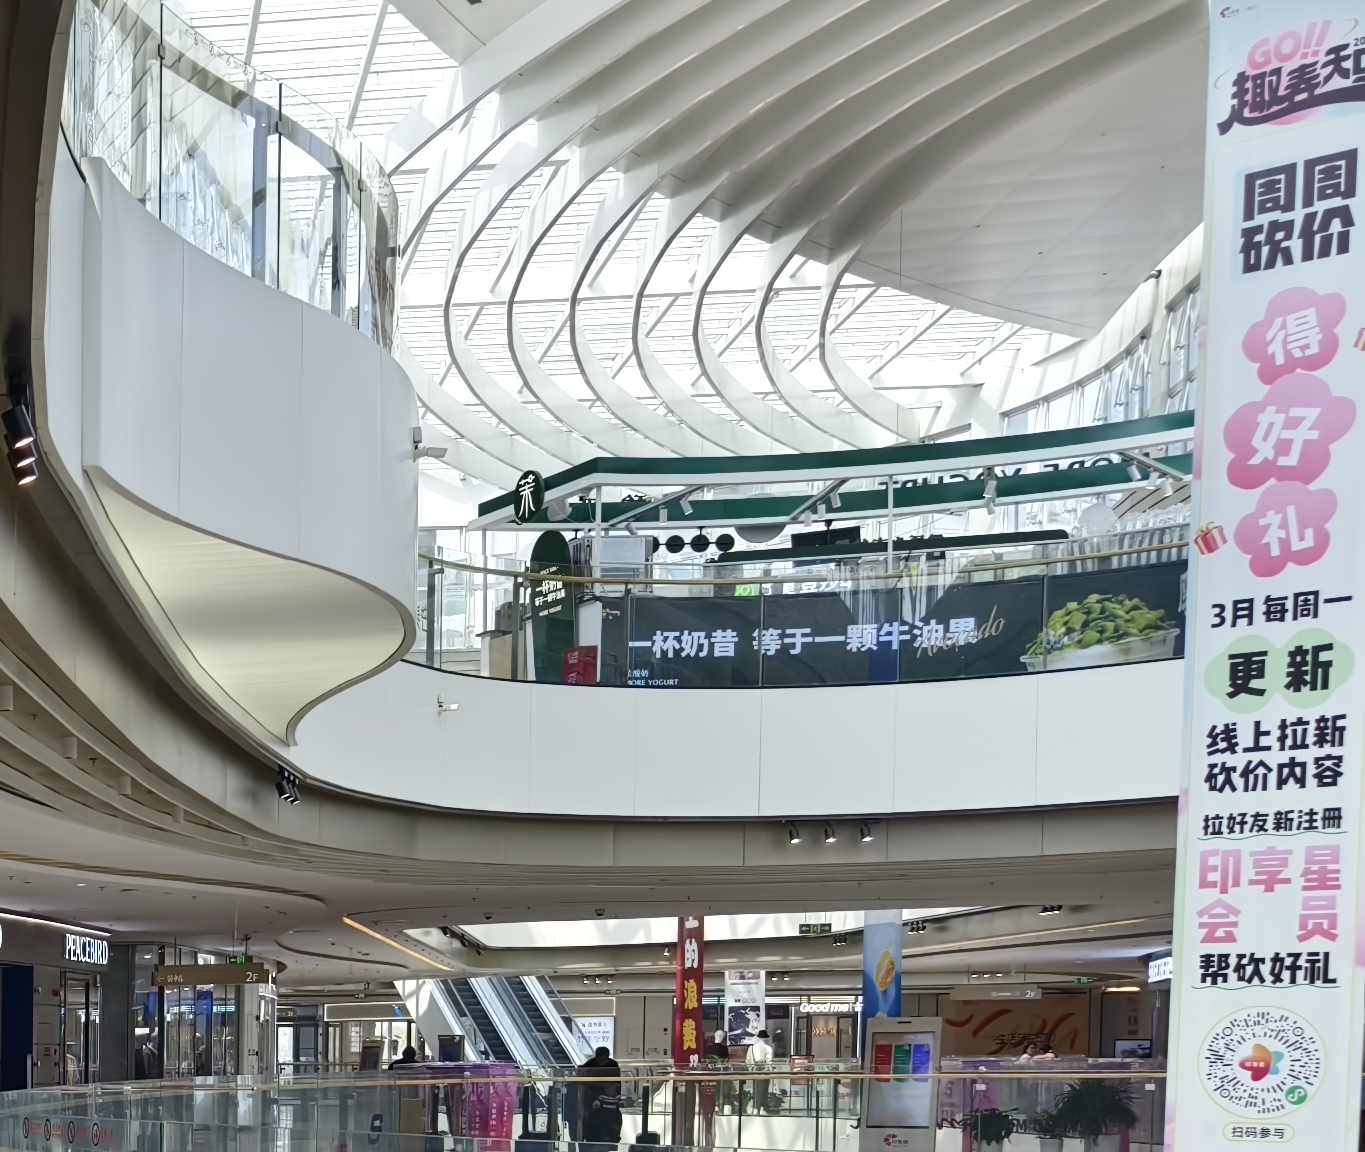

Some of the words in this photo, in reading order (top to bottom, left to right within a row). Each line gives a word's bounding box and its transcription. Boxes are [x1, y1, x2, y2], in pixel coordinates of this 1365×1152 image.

[1247, 20, 1333, 71] GO!!
[1243, 148, 1358, 222] 周周
[1240, 205, 1355, 274] 砍价
[1211, 590, 1353, 628] 3月每周一
[629, 630, 738, 658] 一杯奶昔
[752, 617, 978, 656] 等于一颗牛油果
[1226, 642, 1334, 699] 更新
[1205, 714, 1347, 756] 线上拉新
[1204, 754, 1344, 794] 砍价内容
[1198, 844, 1342, 894] 印享星
[1196, 896, 1339, 944] 会员
[66, 934, 109, 965] PEACEBIRD
[1198, 951, 1337, 985] 帮砍好礼
[246, 971, 259, 982] 2F
[1231, 1126, 1285, 1139] 扫码参与
